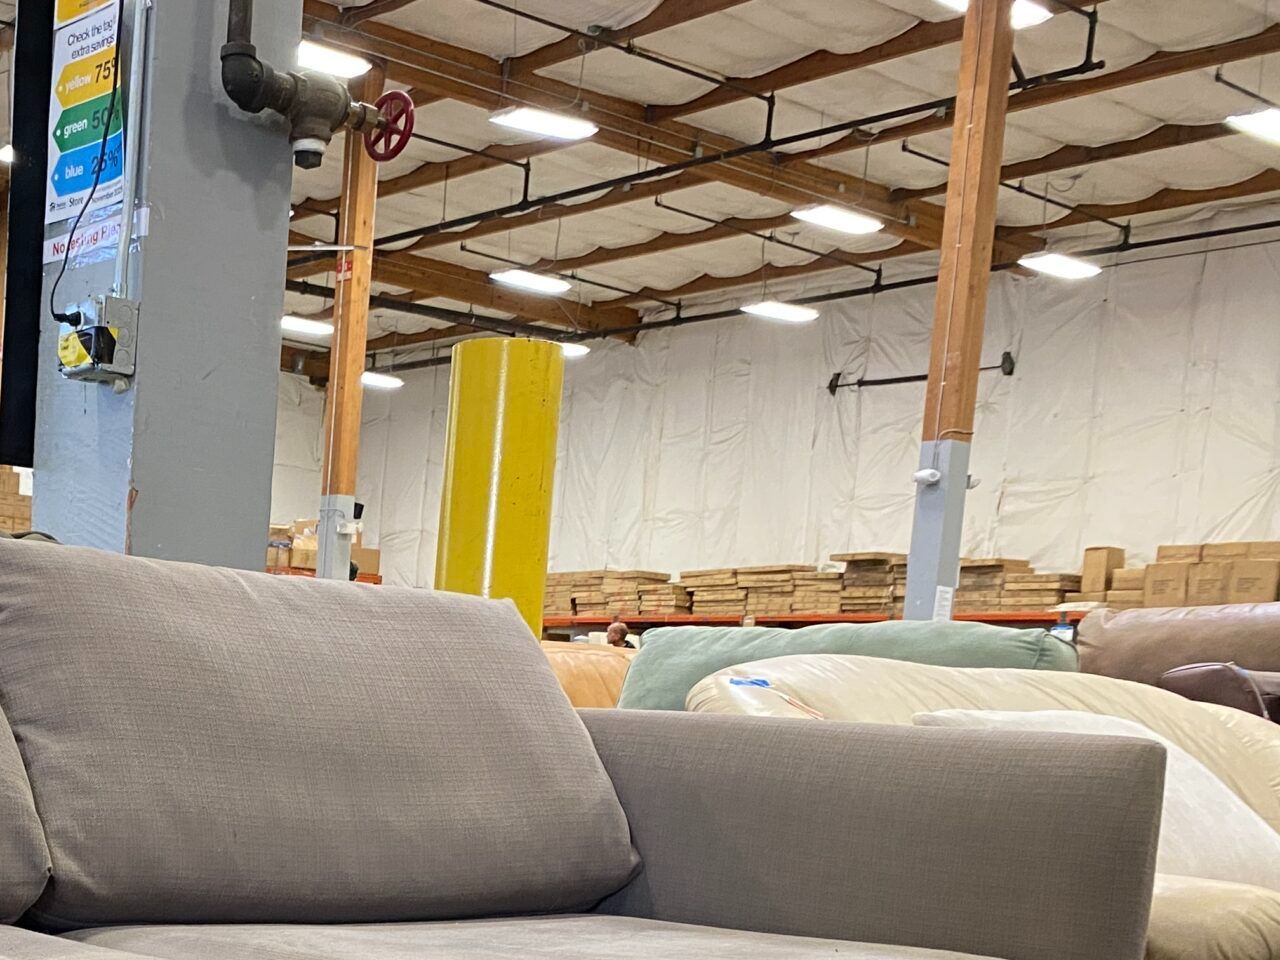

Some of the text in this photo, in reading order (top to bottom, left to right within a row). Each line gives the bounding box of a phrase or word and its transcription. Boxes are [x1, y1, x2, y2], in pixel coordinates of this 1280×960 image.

[67, 28, 90, 46] Check
[91, 24, 102, 35] the
[71, 34, 114, 59] extra savings
[65, 74, 91, 95] yellow
[63, 119, 87, 138] green
[65, 165, 83, 179] blue
[53, 242, 65, 256] No
[67, 231, 99, 252] esting
